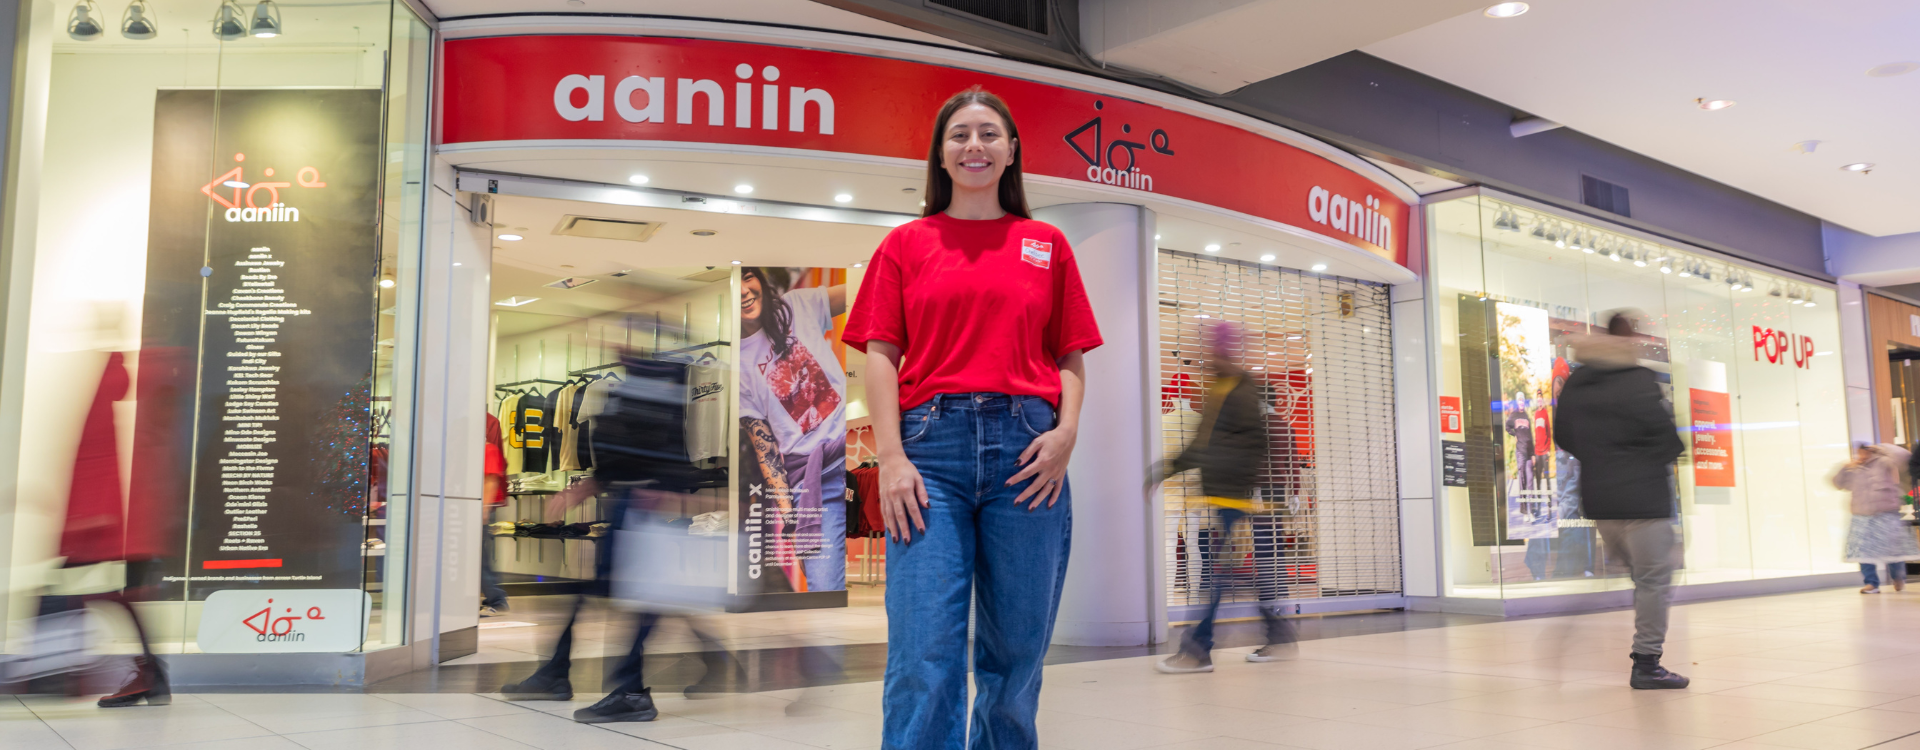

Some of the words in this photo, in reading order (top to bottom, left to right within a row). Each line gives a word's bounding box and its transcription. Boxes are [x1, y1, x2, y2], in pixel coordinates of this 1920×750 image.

[554, 63, 834, 135] aaniin
[1087, 165, 1152, 191] aaniin
[225, 202, 299, 222] aaniin
[1308, 186, 1391, 251] aaniin
[1752, 325, 1788, 365] POP
[1792, 333, 1814, 369] UP
[749, 484, 762, 496] x
[1558, 516, 1597, 528] onversation
[745, 503, 762, 579] aaniin
[256, 630, 305, 642] aaniin
